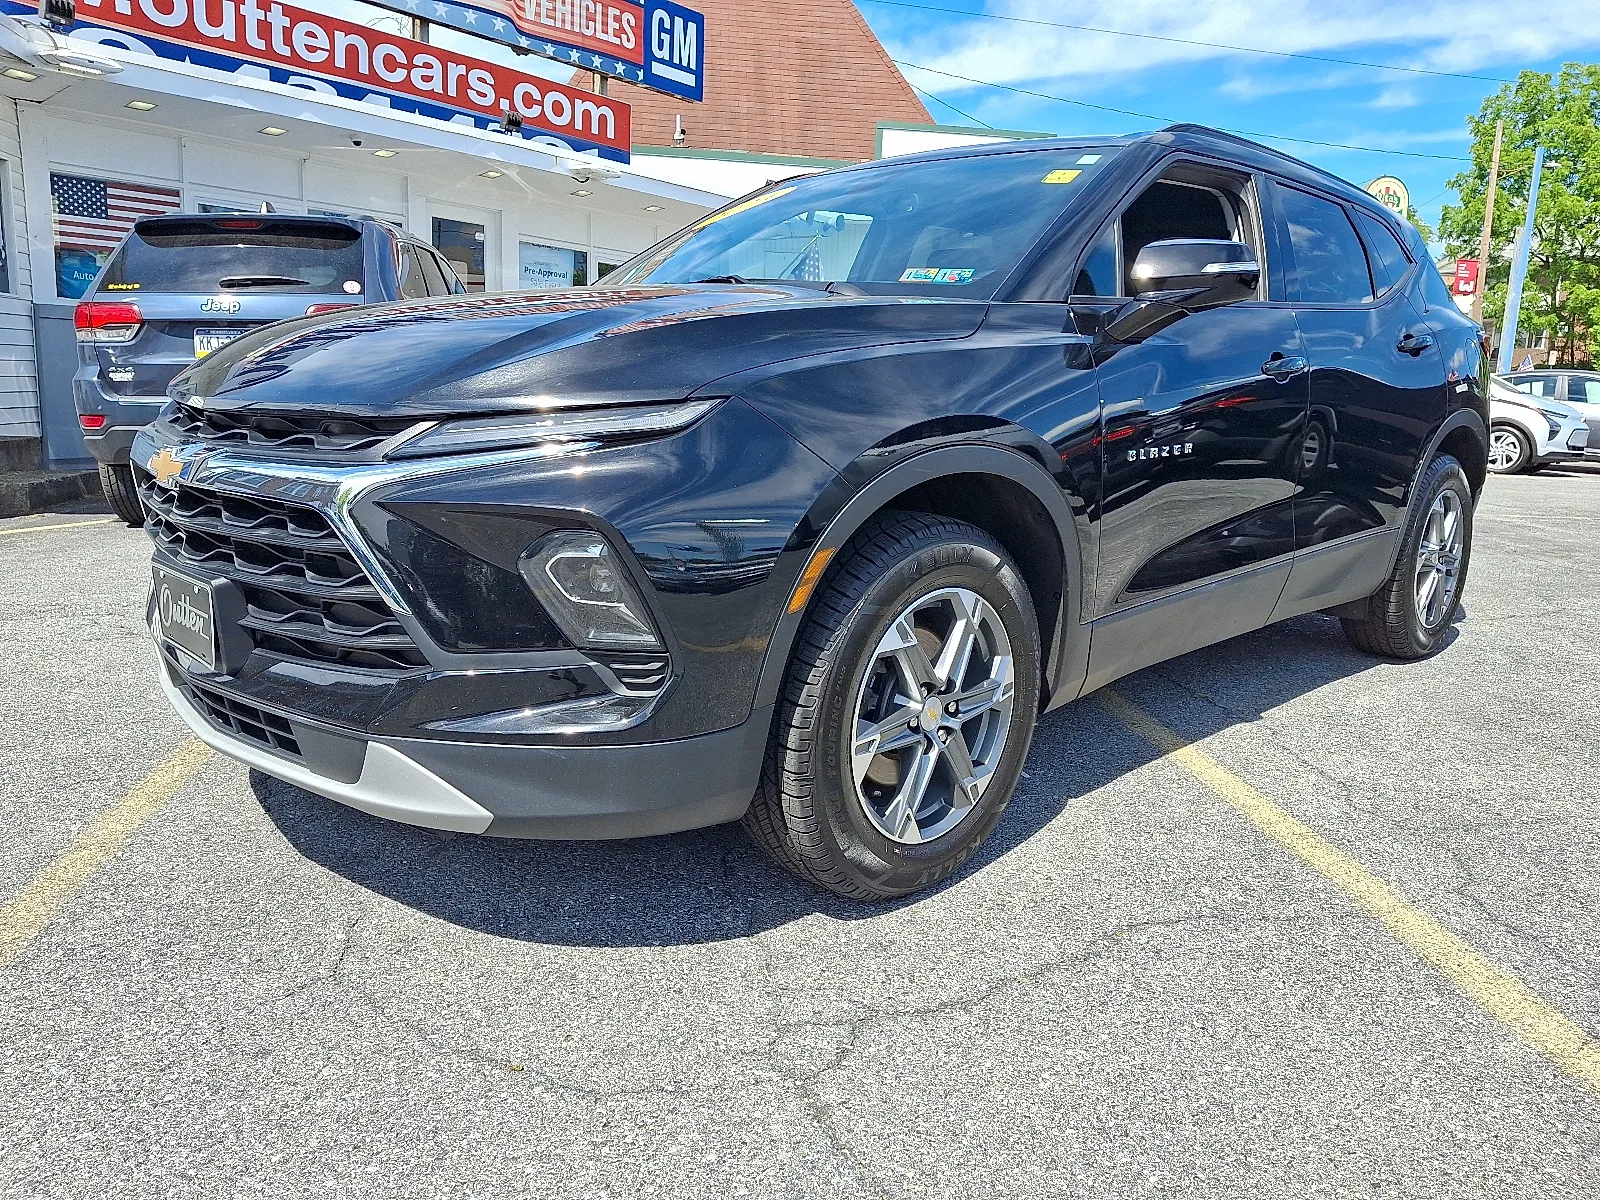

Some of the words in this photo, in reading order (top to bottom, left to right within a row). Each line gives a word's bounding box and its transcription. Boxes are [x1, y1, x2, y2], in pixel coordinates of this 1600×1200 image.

[651, 8, 697, 71] GM
[73, 270, 95, 281] Auto
[524, 265, 568, 279] Pre-Approval
[200, 298, 241, 314] Jeep
[1127, 442, 1194, 462] BLAZER
